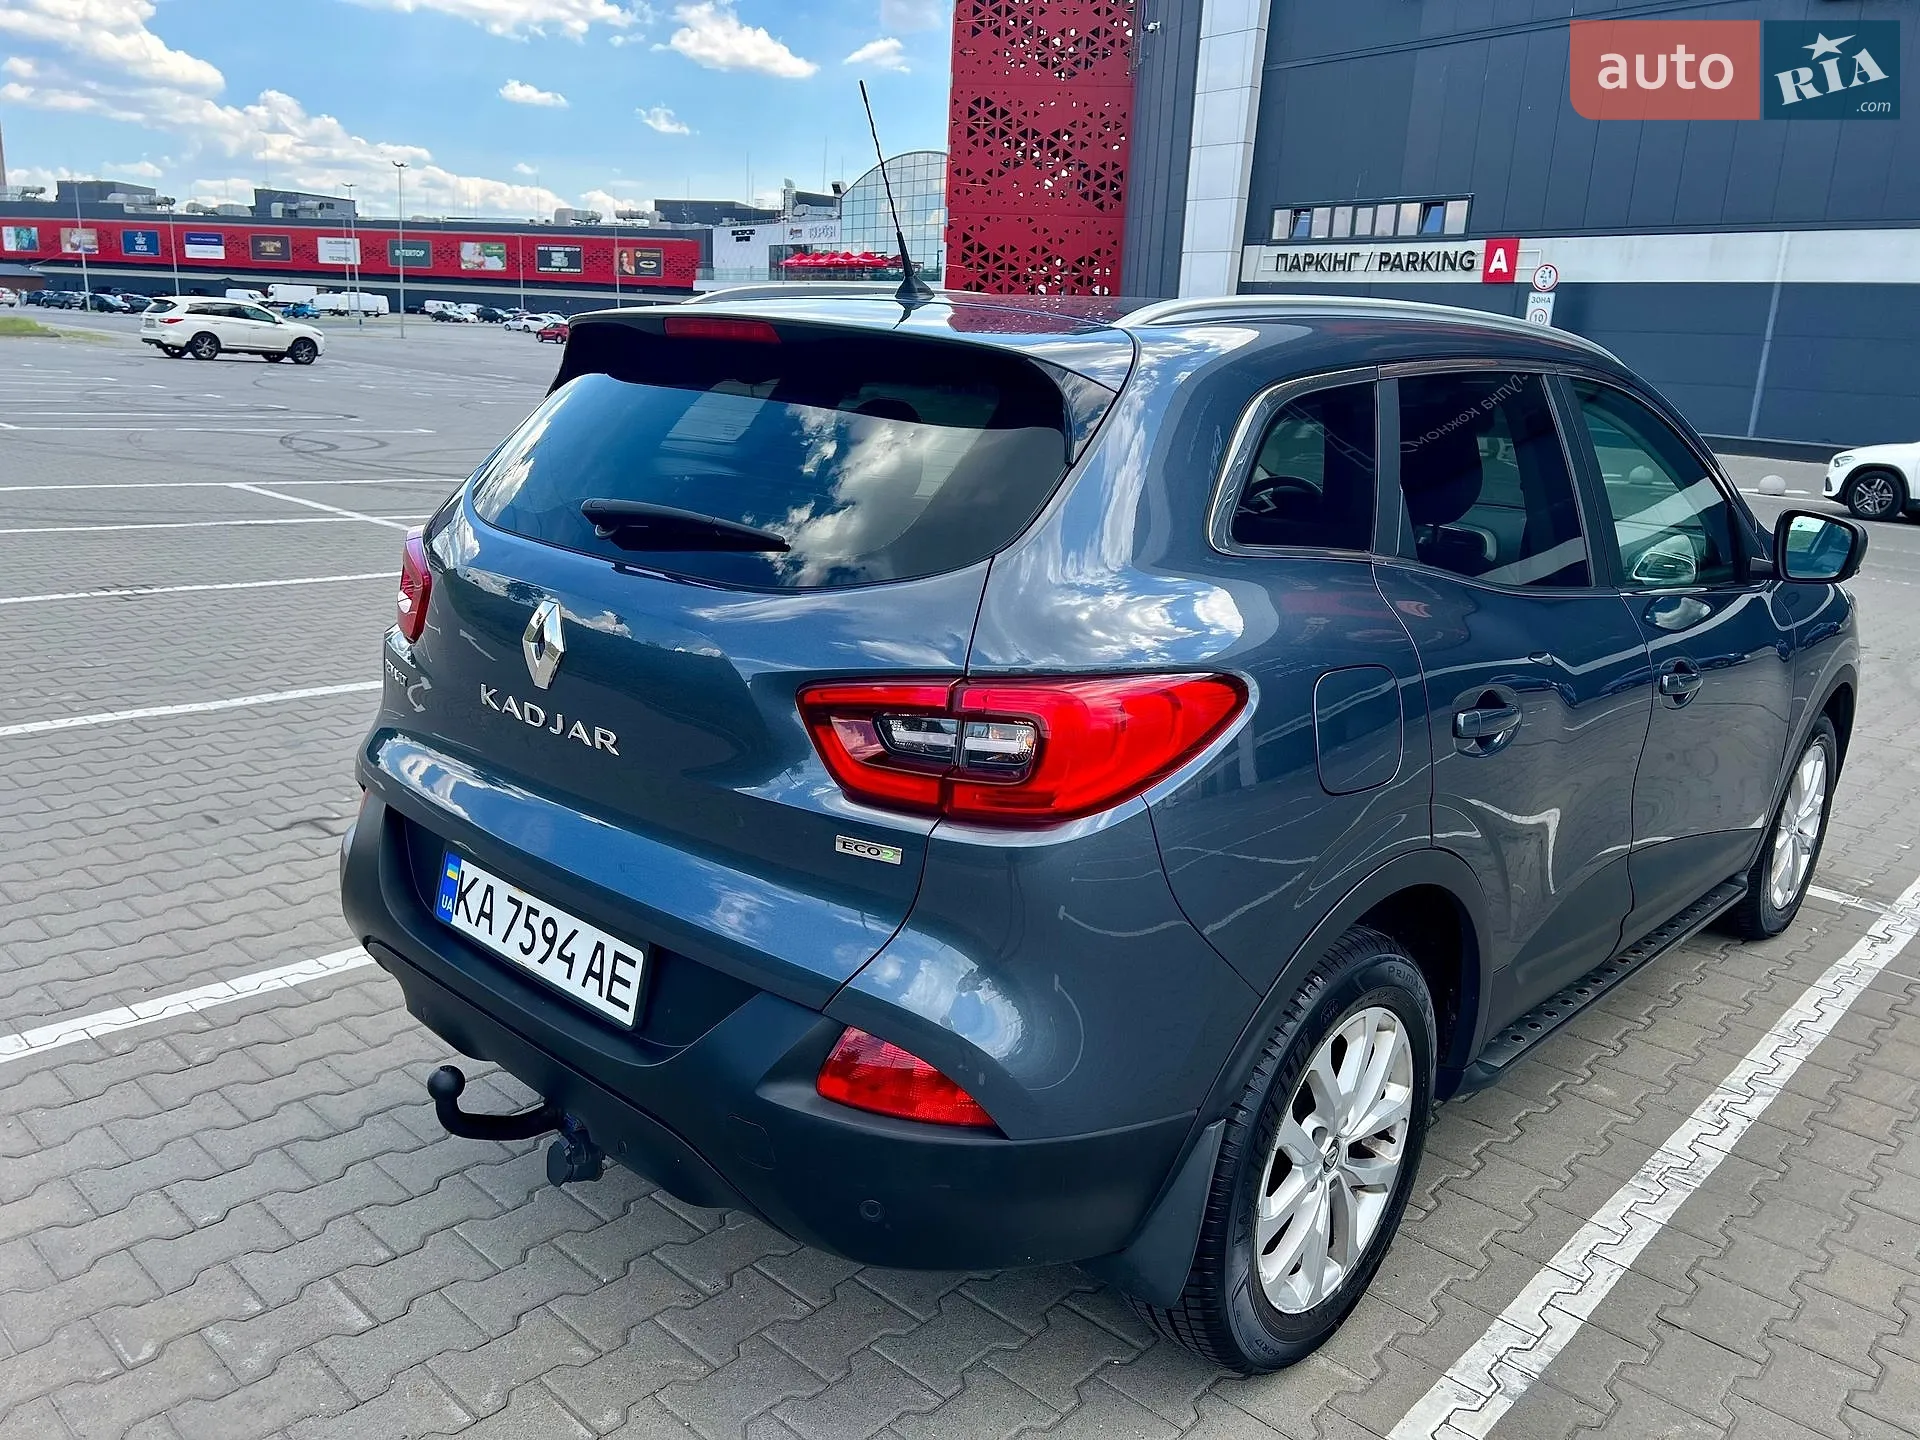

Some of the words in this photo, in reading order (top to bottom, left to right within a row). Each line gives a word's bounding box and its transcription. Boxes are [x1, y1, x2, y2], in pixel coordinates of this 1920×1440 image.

[1275, 252, 1360, 273] ПАРКІНГ
[1364, 251, 1375, 273] /
[1378, 250, 1476, 272] PARKING
[1488, 247, 1509, 274] A
[1531, 296, 1551, 304] ЗОНА
[1534, 313, 1544, 323] 10
[480, 683, 621, 756] KADJAR
[441, 894, 453, 913] UA
[454, 870, 496, 936] KA
[501, 894, 579, 981] 7594
[581, 940, 637, 1012] AE
